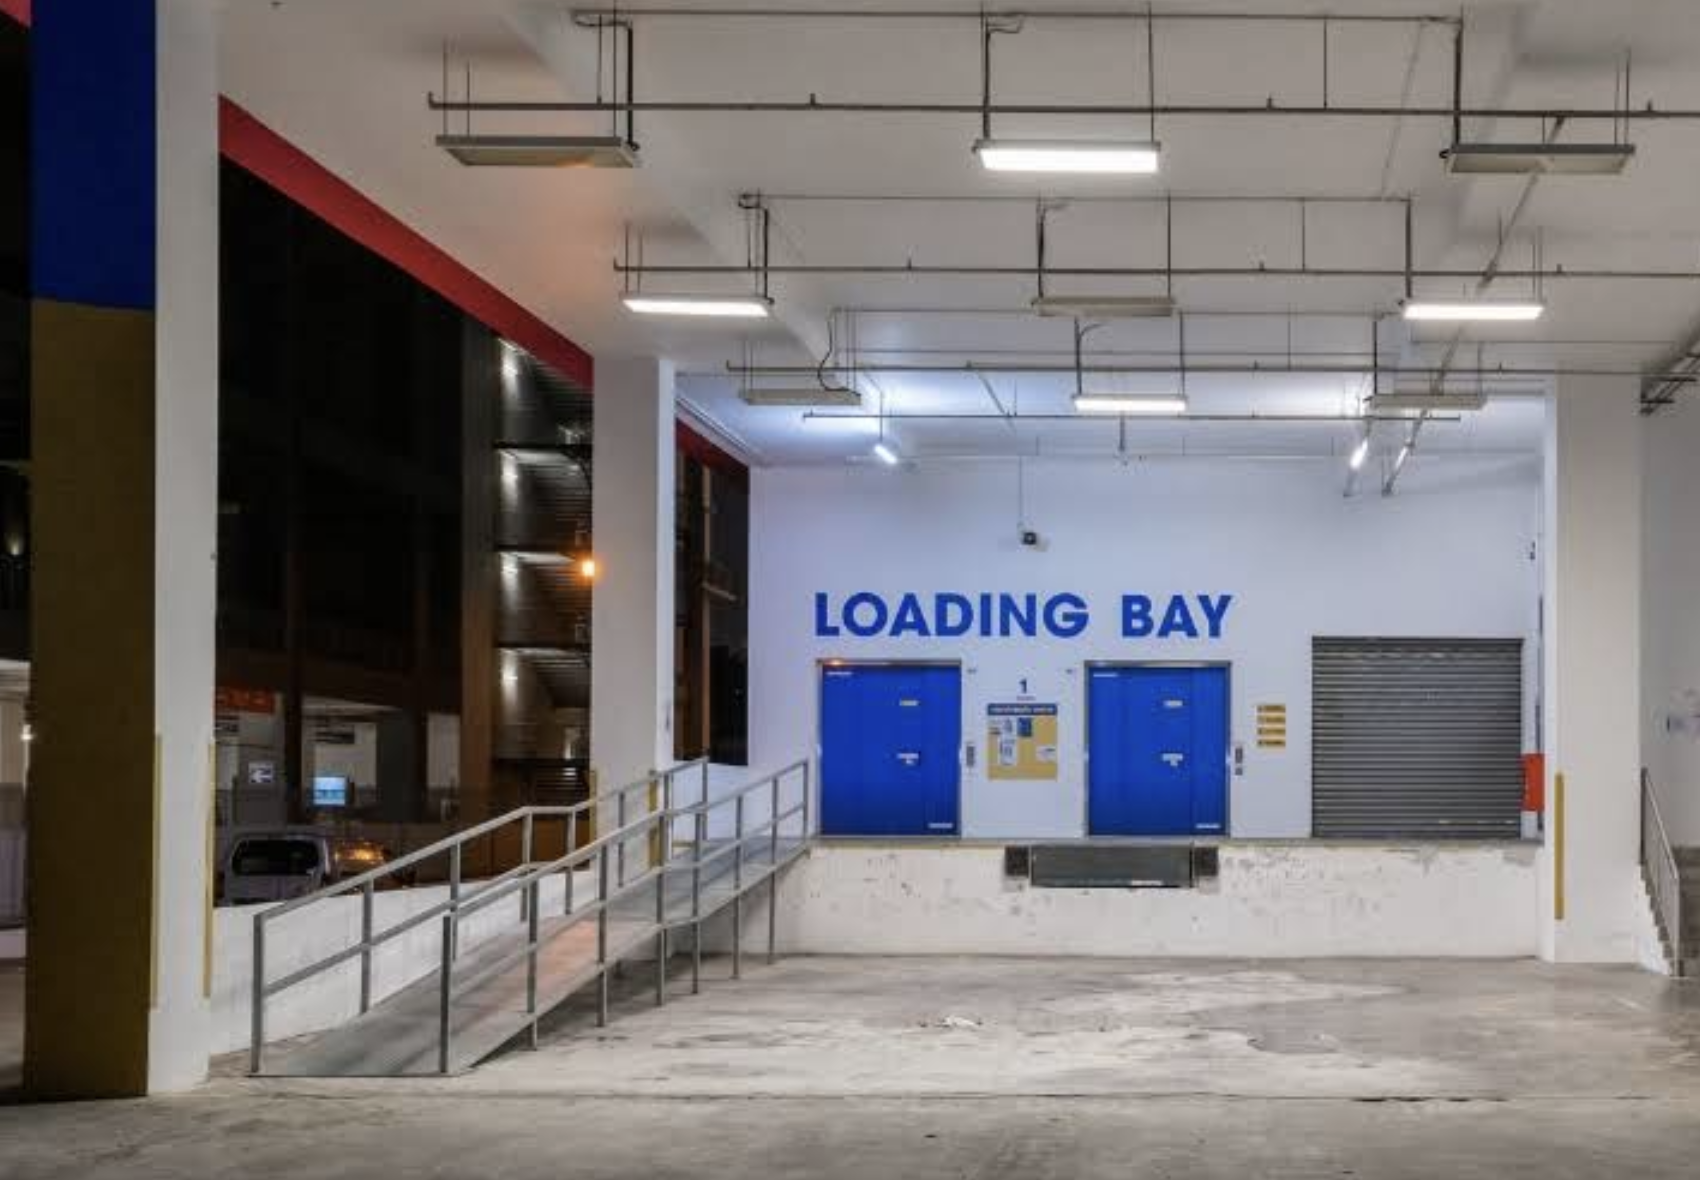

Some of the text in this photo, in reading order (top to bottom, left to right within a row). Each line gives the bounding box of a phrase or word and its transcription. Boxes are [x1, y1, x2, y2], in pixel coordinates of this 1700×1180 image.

[814, 591, 1233, 638] LOADING BAY
[1018, 678, 1028, 694] 1
